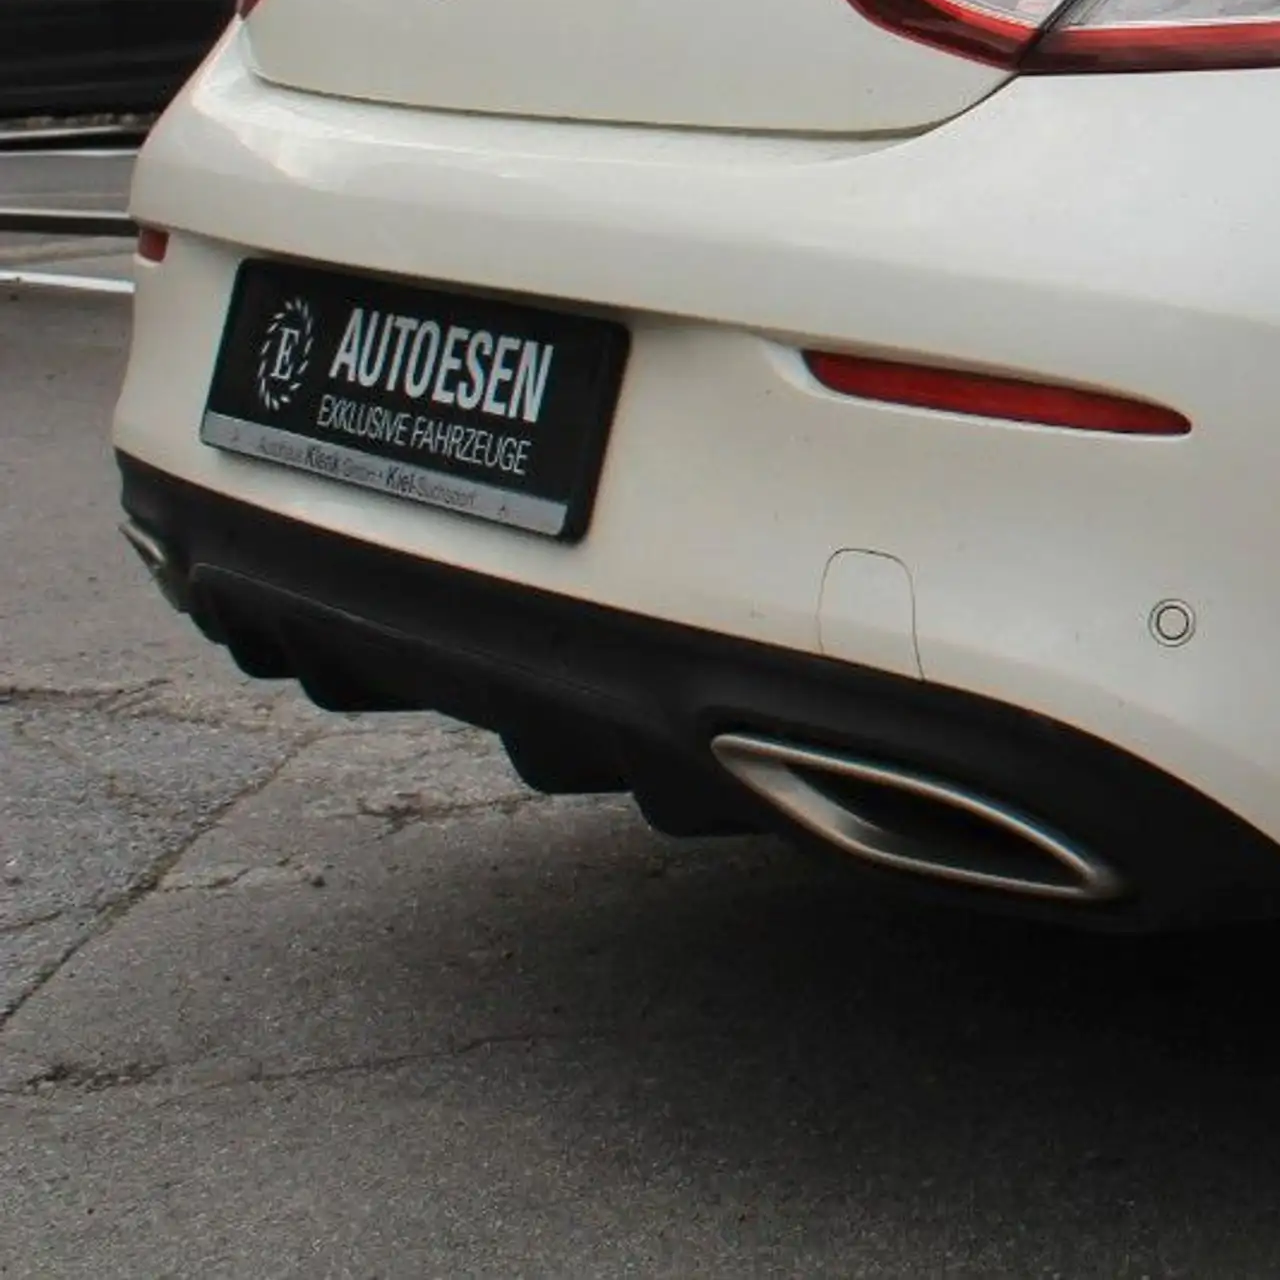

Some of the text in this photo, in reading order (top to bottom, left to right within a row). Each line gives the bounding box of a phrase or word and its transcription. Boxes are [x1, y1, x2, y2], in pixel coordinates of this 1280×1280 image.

[329, 306, 554, 423] AUTOESEN
[316, 393, 407, 448] EXKLUSIVE
[410, 414, 533, 477] FAHRZEUGE
